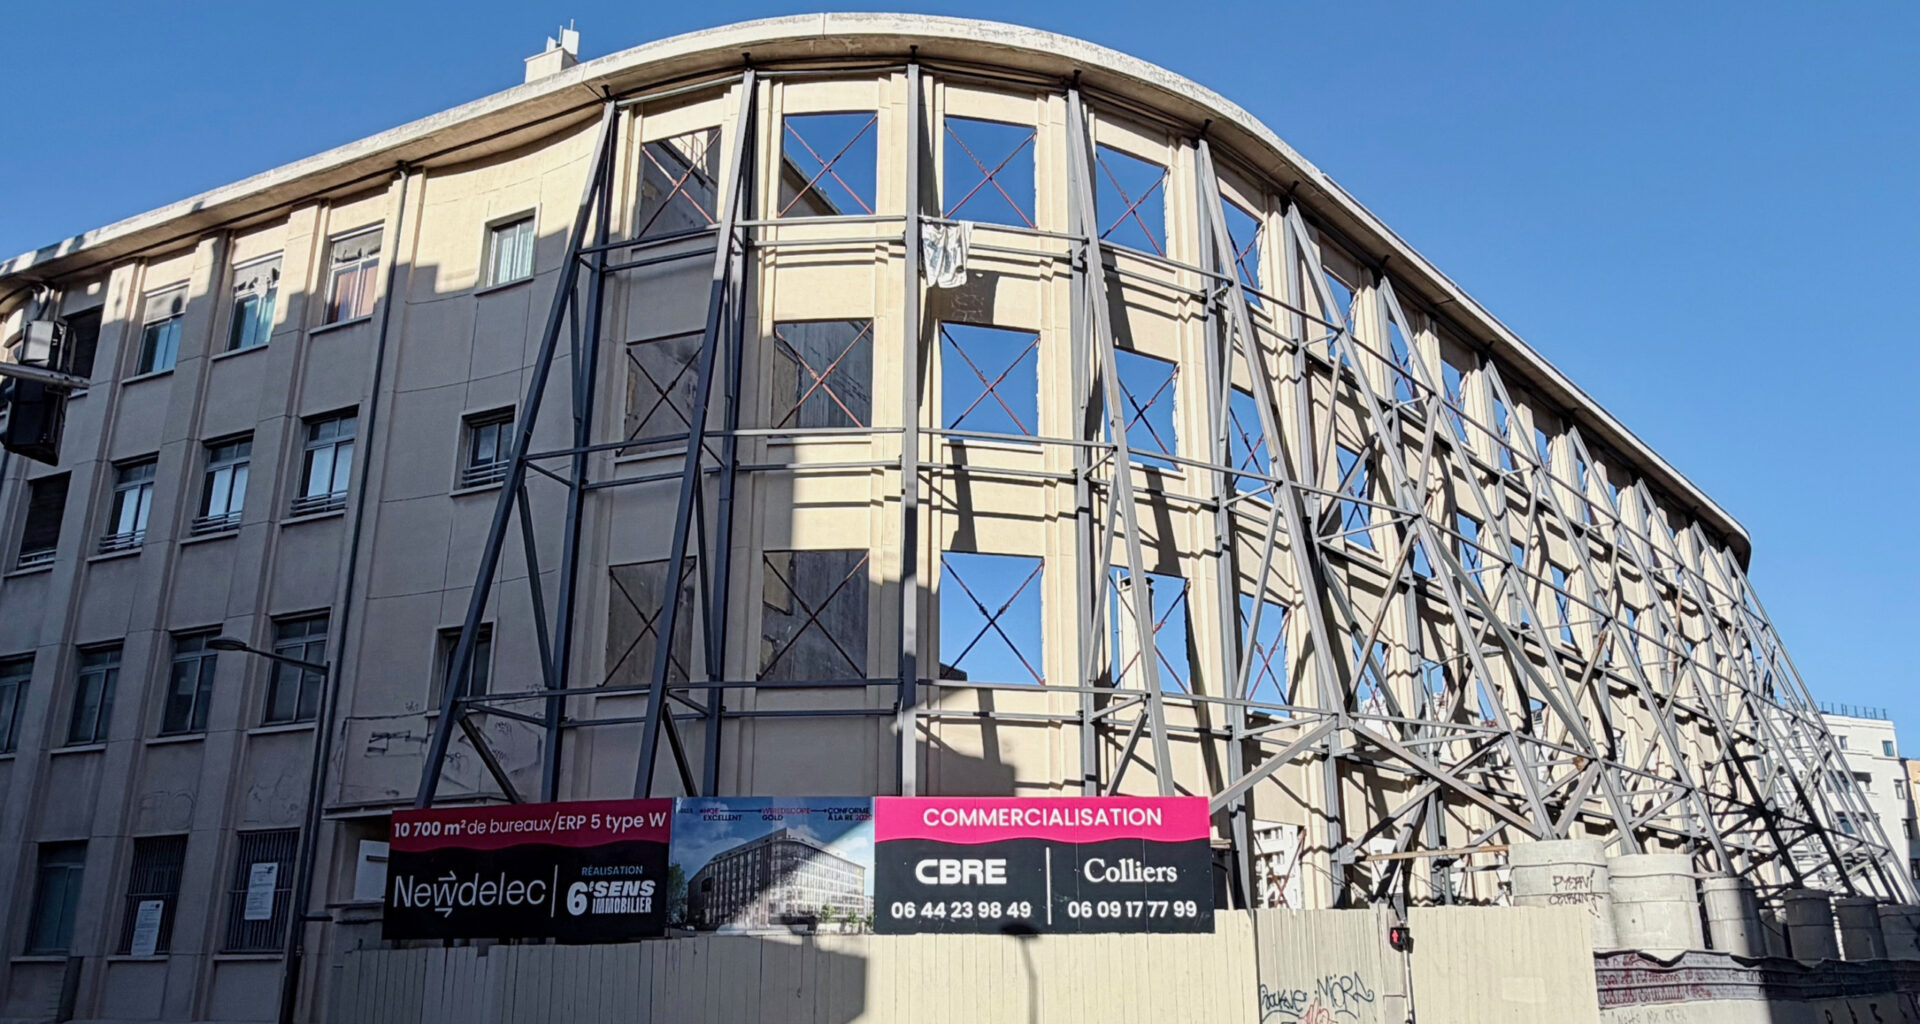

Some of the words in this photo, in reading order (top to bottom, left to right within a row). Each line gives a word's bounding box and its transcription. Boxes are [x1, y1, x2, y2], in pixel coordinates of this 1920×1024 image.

[703, 814, 742, 822] EXCELLENT
[827, 807, 871, 815] CONFORME
[923, 808, 1162, 827] COMMERCIALISATION
[394, 822, 411, 838] 10
[413, 821, 441, 836] 700
[467, 819, 487, 834] de
[590, 813, 602, 829] 5
[605, 813, 645, 834] type
[648, 811, 667, 828] W
[581, 864, 643, 876] RÉALISATION
[915, 858, 1008, 885] CBRE
[1083, 857, 1178, 883] Colliers
[393, 871, 547, 909] Newdelec
[591, 897, 652, 915] IMMOBILIER
[890, 901, 916, 919] 06
[920, 901, 947, 919] 44
[950, 901, 974, 919] 23
[977, 901, 1002, 919] 98
[1006, 901, 1032, 919] 49
[1067, 900, 1093, 919] 06
[1097, 900, 1122, 919] 09
[1125, 900, 1144, 918] 17
[1146, 900, 1169, 918] 77
[1172, 899, 1197, 918] 99
